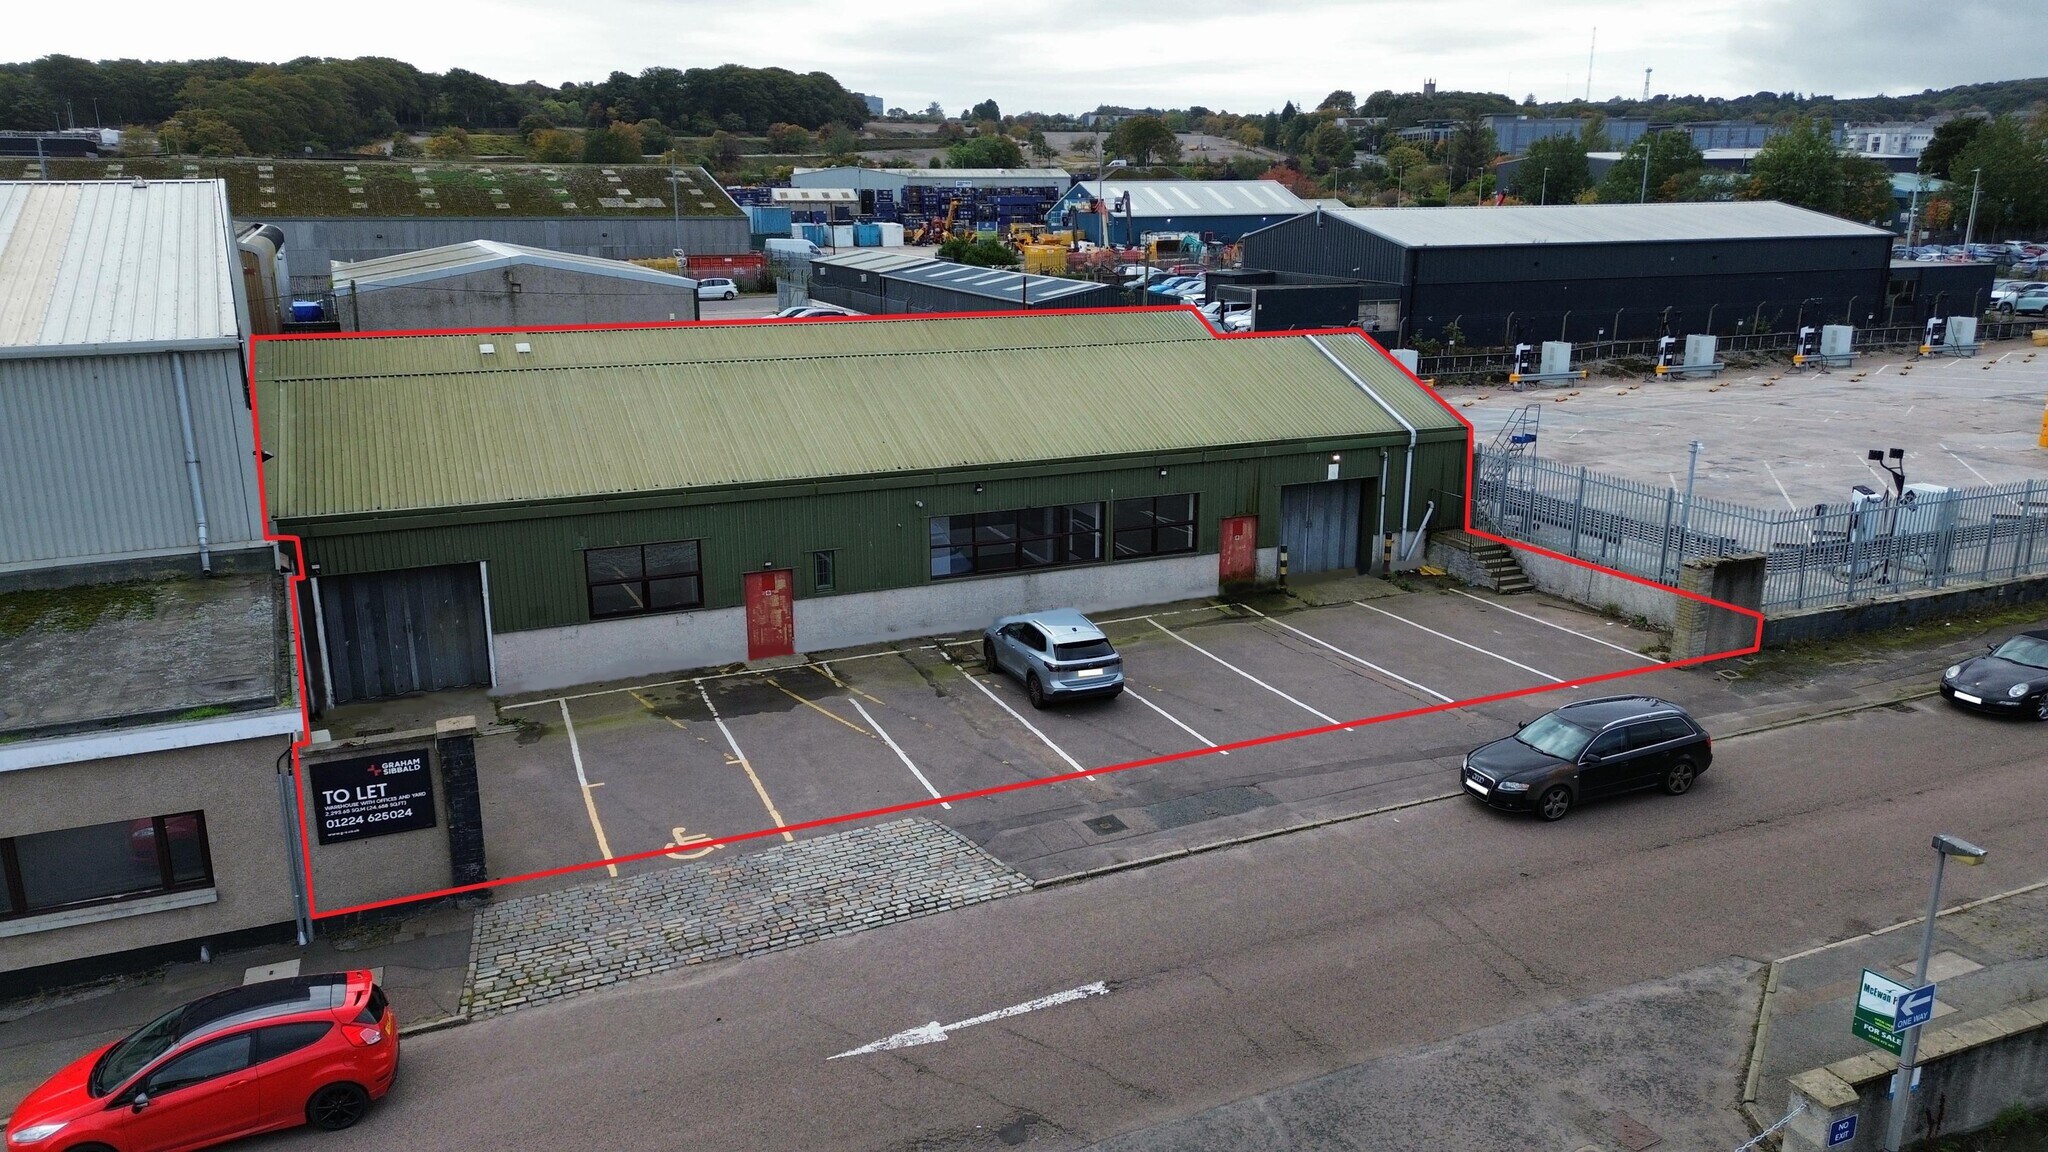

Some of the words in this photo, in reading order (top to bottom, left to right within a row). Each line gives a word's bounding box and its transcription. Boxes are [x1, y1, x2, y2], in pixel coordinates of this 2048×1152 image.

[382, 758, 420, 769] GRAHAM
[383, 764, 420, 775] SIBBALD
[322, 788, 350, 804] TO
[356, 783, 387, 800] LET
[324, 802, 359, 810] WAREHOUSE
[376, 796, 397, 804] OFFICES
[326, 815, 364, 828] 01224
[367, 808, 412, 821] 625024
[1863, 983, 1891, 1003] McEwan
[1897, 1017, 1912, 1029] ONE
[1914, 1011, 1929, 1022] WAY
[1863, 1023, 1880, 1036] FOR
[1881, 1031, 1903, 1046] SALE
[1838, 1121, 1849, 1131] NO
[1834, 1131, 1849, 1141] EXIT
